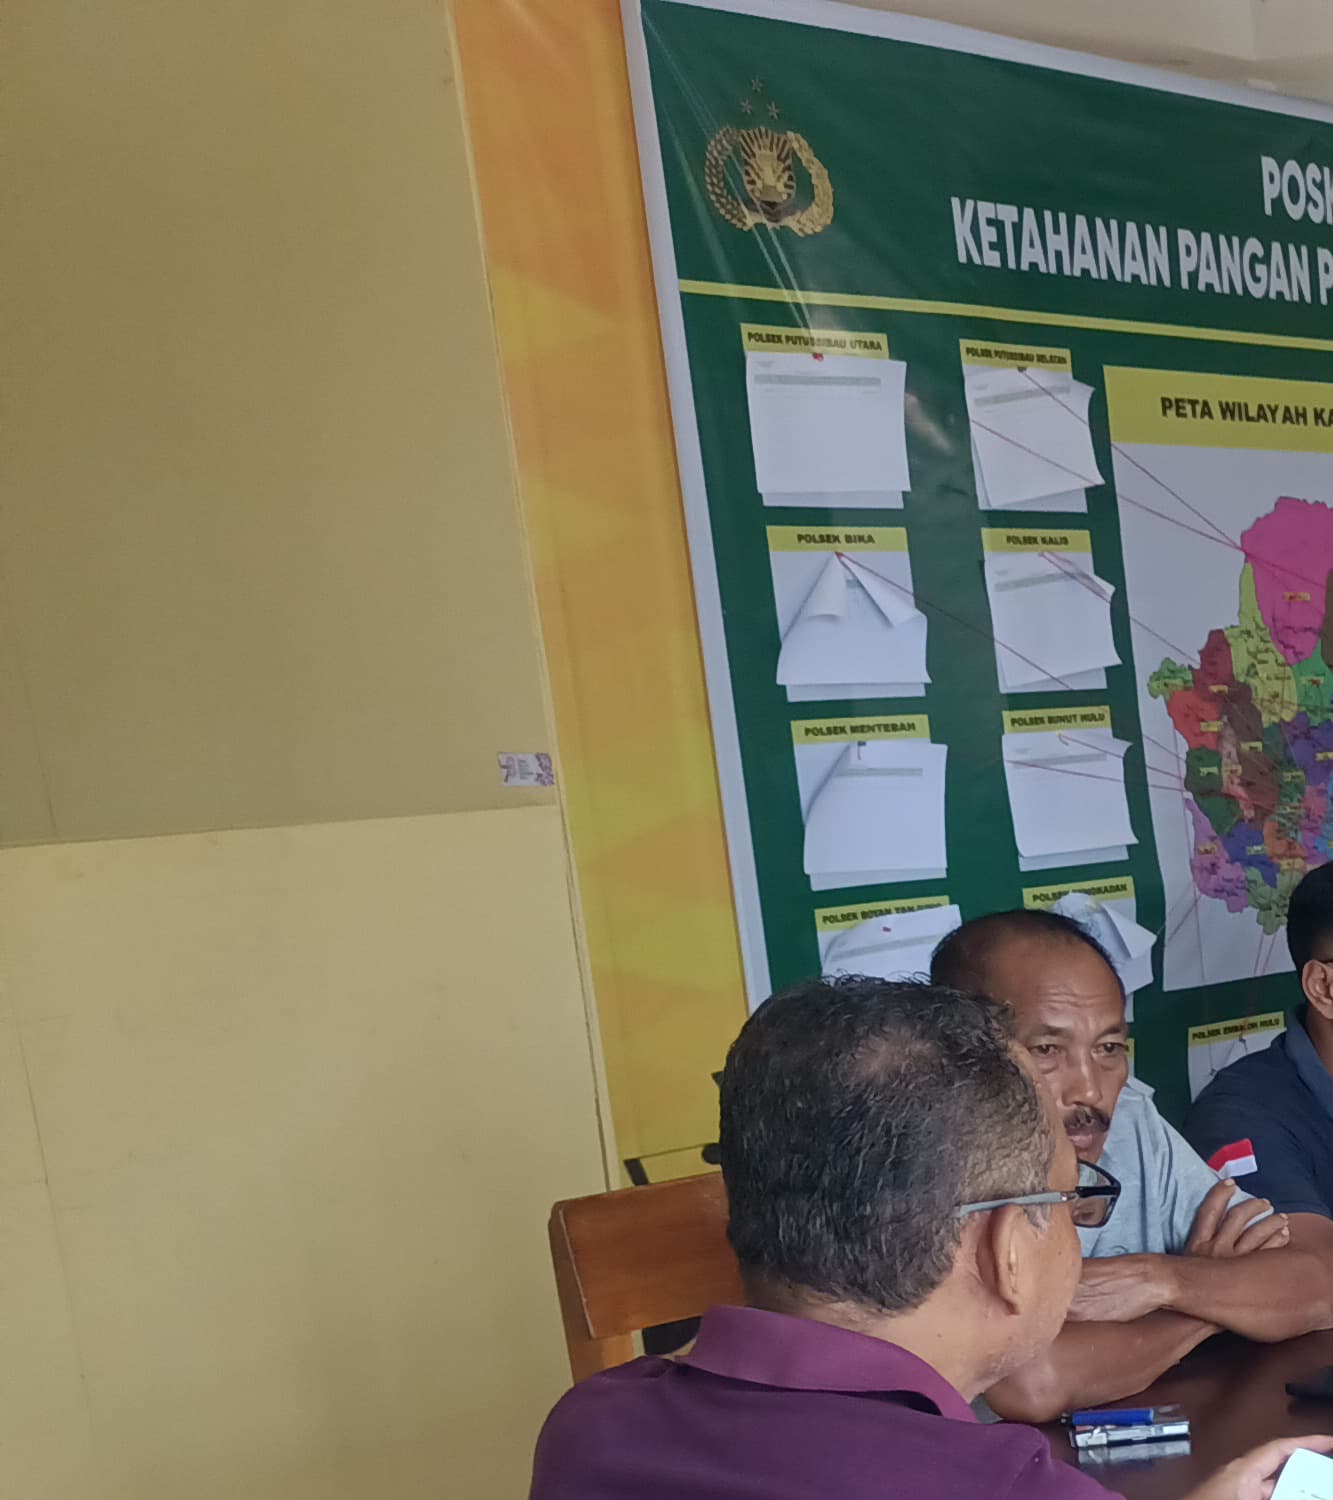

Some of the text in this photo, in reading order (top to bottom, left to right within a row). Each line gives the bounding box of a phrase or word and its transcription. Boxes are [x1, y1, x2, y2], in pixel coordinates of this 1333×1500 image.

[951, 196, 1171, 289] KETAHANAN
[1177, 227, 1310, 305] PANGAN
[747, 331, 783, 345] POLSEK
[850, 339, 882, 351] UTARA
[1160, 396, 1214, 420] PETA
[1218, 400, 1308, 426] WILAYAH
[797, 534, 841, 544] POLSEK
[1006, 535, 1039, 546] POLSEK
[1010, 716, 1045, 728] POLSEK
[804, 725, 848, 737] POLSEK
[822, 911, 859, 924] POLSEK
